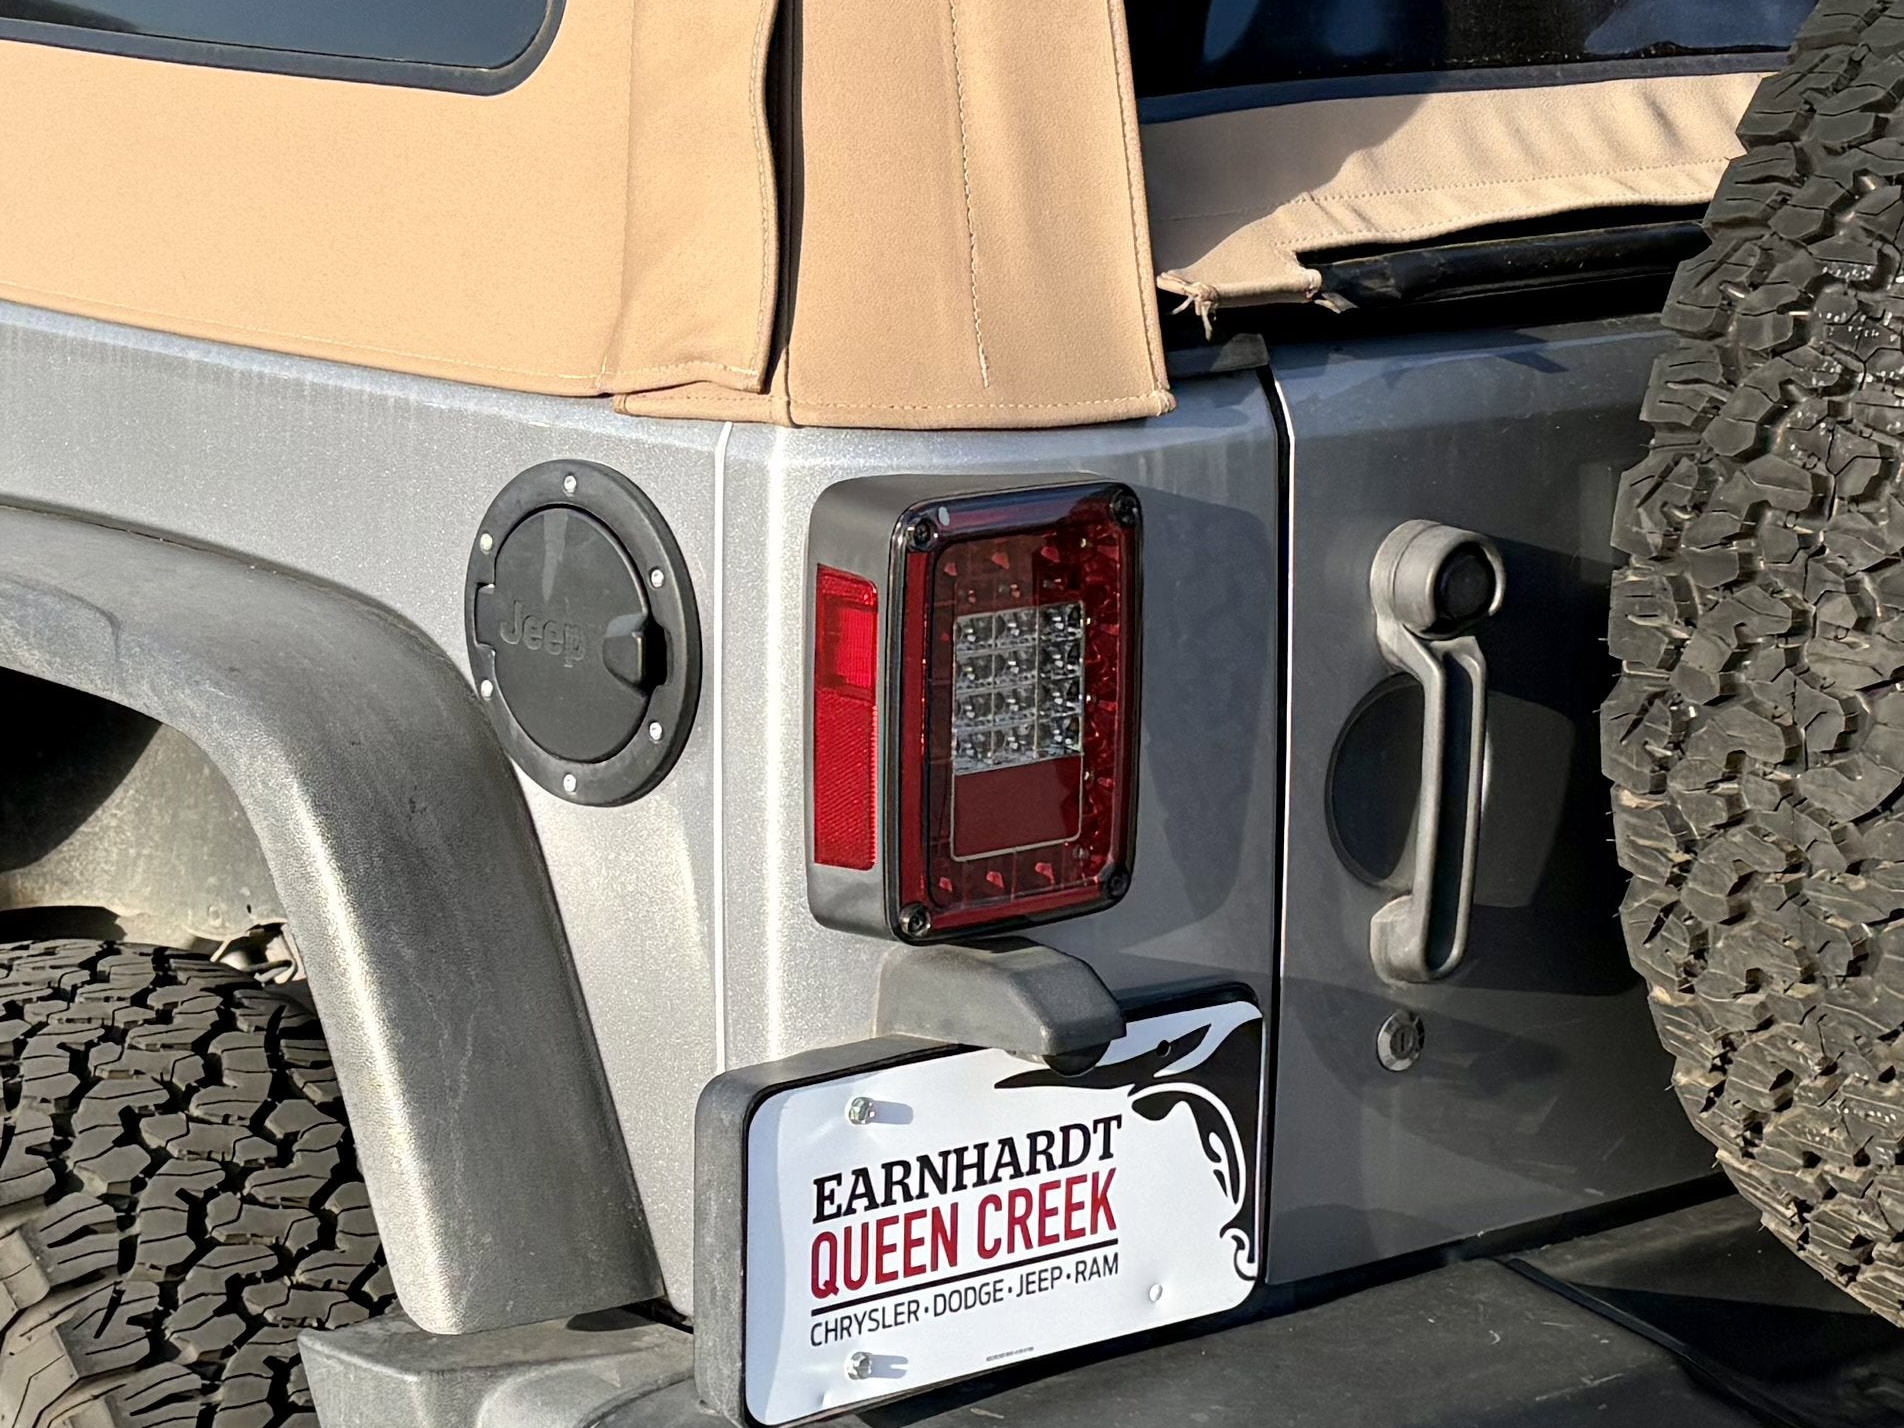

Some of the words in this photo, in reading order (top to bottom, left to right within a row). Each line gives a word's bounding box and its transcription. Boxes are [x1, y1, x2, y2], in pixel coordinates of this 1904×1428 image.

[499, 599, 586, 669] Jeep
[812, 1113, 1123, 1225] EARNHARDT
[810, 1201, 959, 1300] QUEEN
[976, 1166, 1118, 1261] CREEK
[809, 1298, 921, 1348] CHRYSLER
[932, 1278, 1005, 1318] DODGE
[1015, 1264, 1064, 1298] JEEP
[1073, 1251, 1120, 1285] RAM
